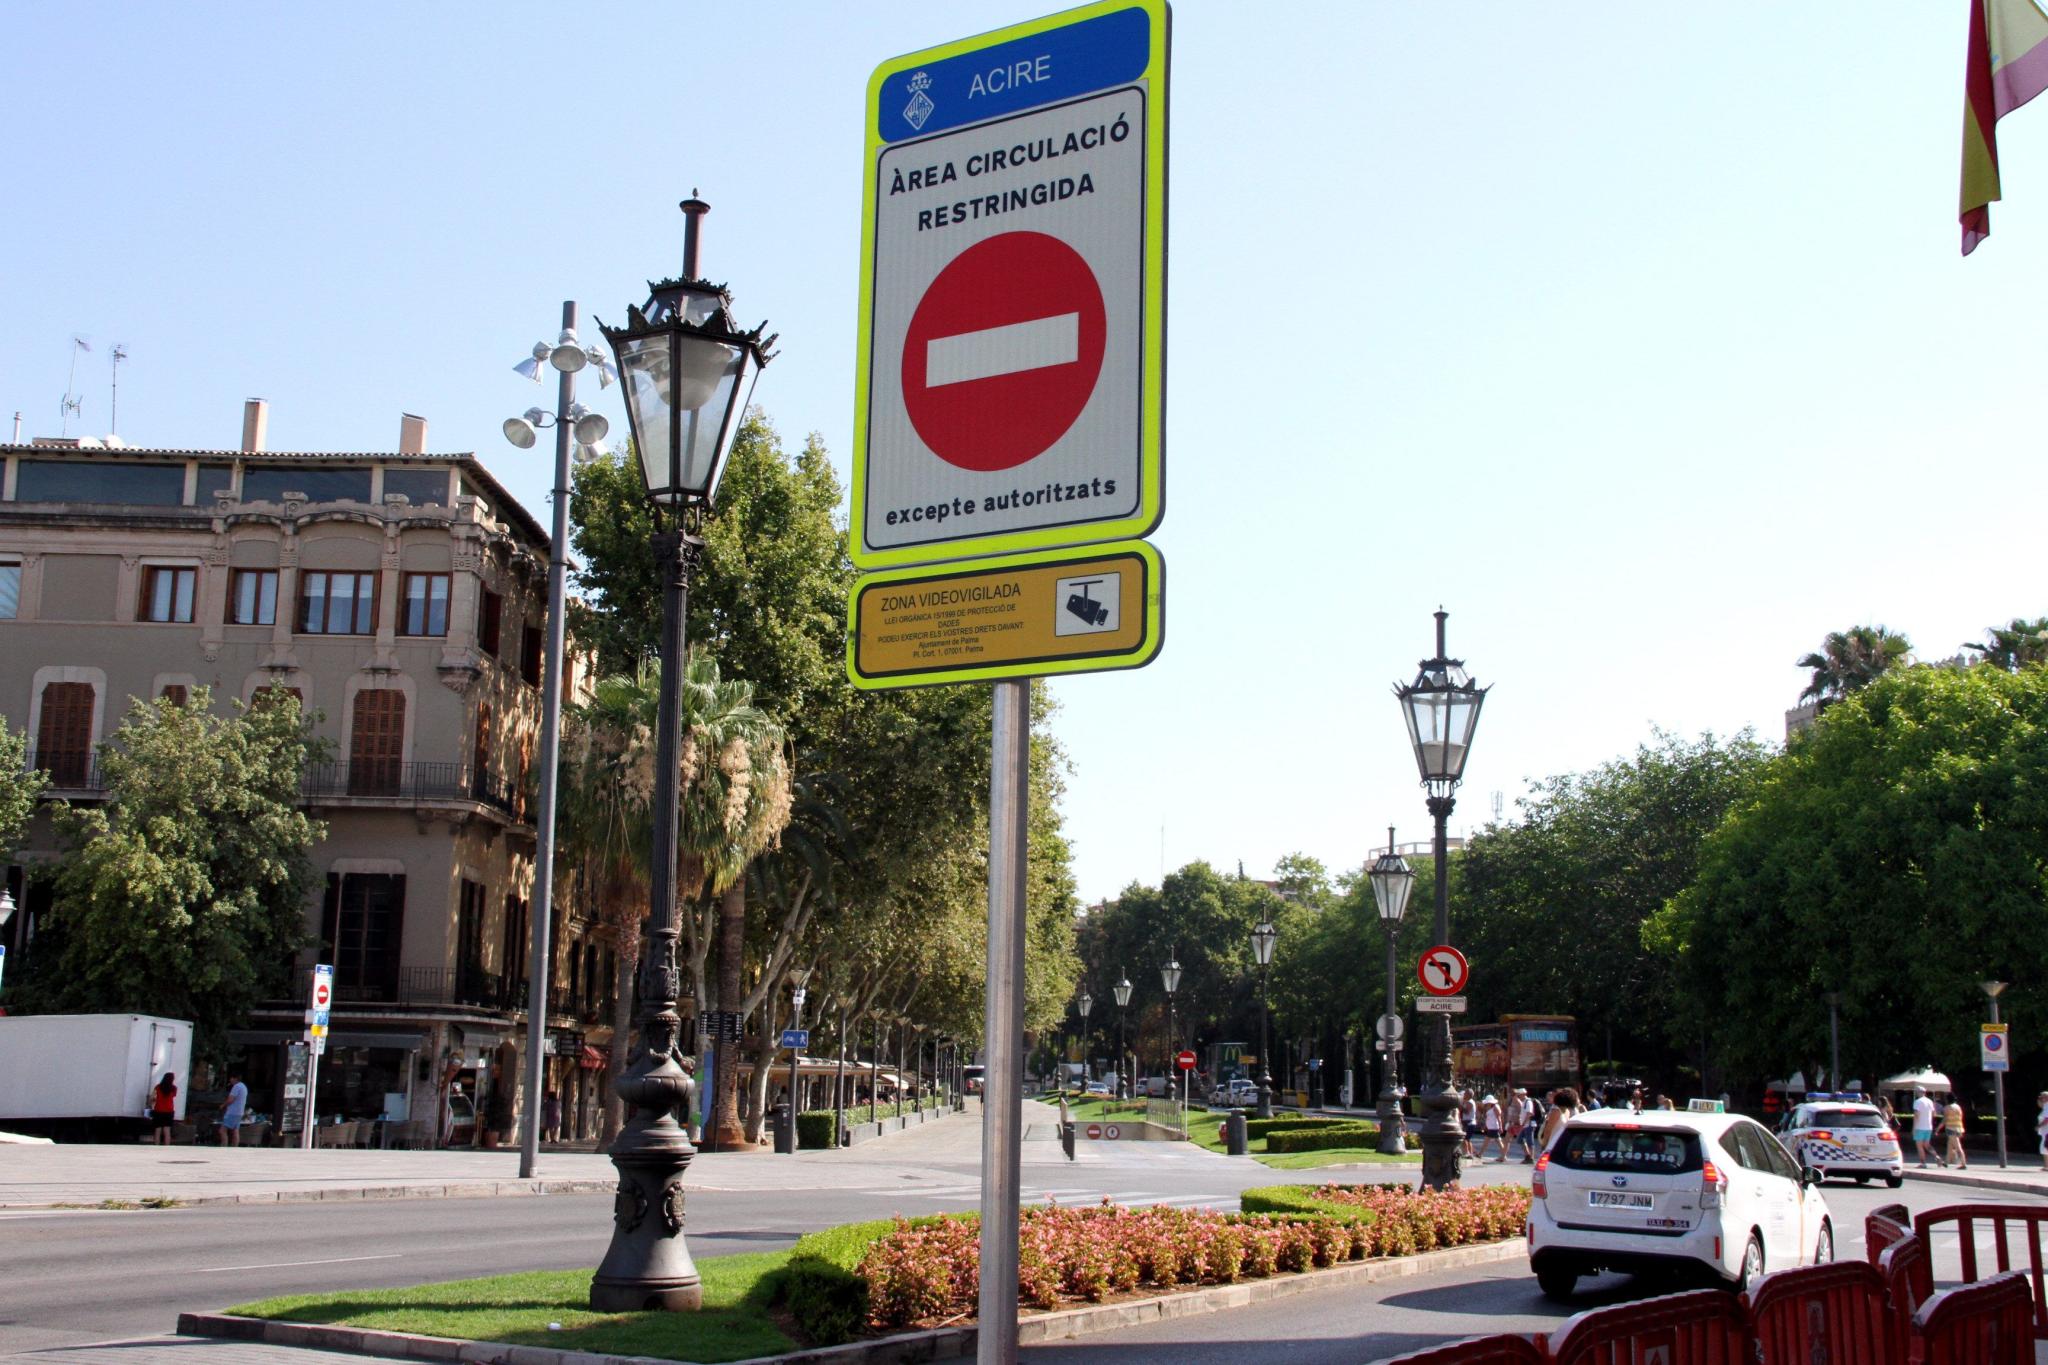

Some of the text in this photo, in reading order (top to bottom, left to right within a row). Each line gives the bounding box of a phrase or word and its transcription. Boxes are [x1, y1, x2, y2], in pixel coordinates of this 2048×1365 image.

[968, 55, 1051, 99] ACIRE
[890, 112, 1129, 196] ÀREA CIRCULACIÓ
[918, 173, 1095, 231] RESTRINGIDA
[886, 477, 1116, 525] excepte autoritzats
[881, 583, 1021, 612] ZONA VIDEOVIGILADA
[957, 609, 966, 617] DE
[930, 630, 941, 638] ELS
[943, 626, 973, 637] VOSTRES
[975, 624, 997, 633] DRETS
[1596, 1192, 1652, 1208] 7797 JNM
